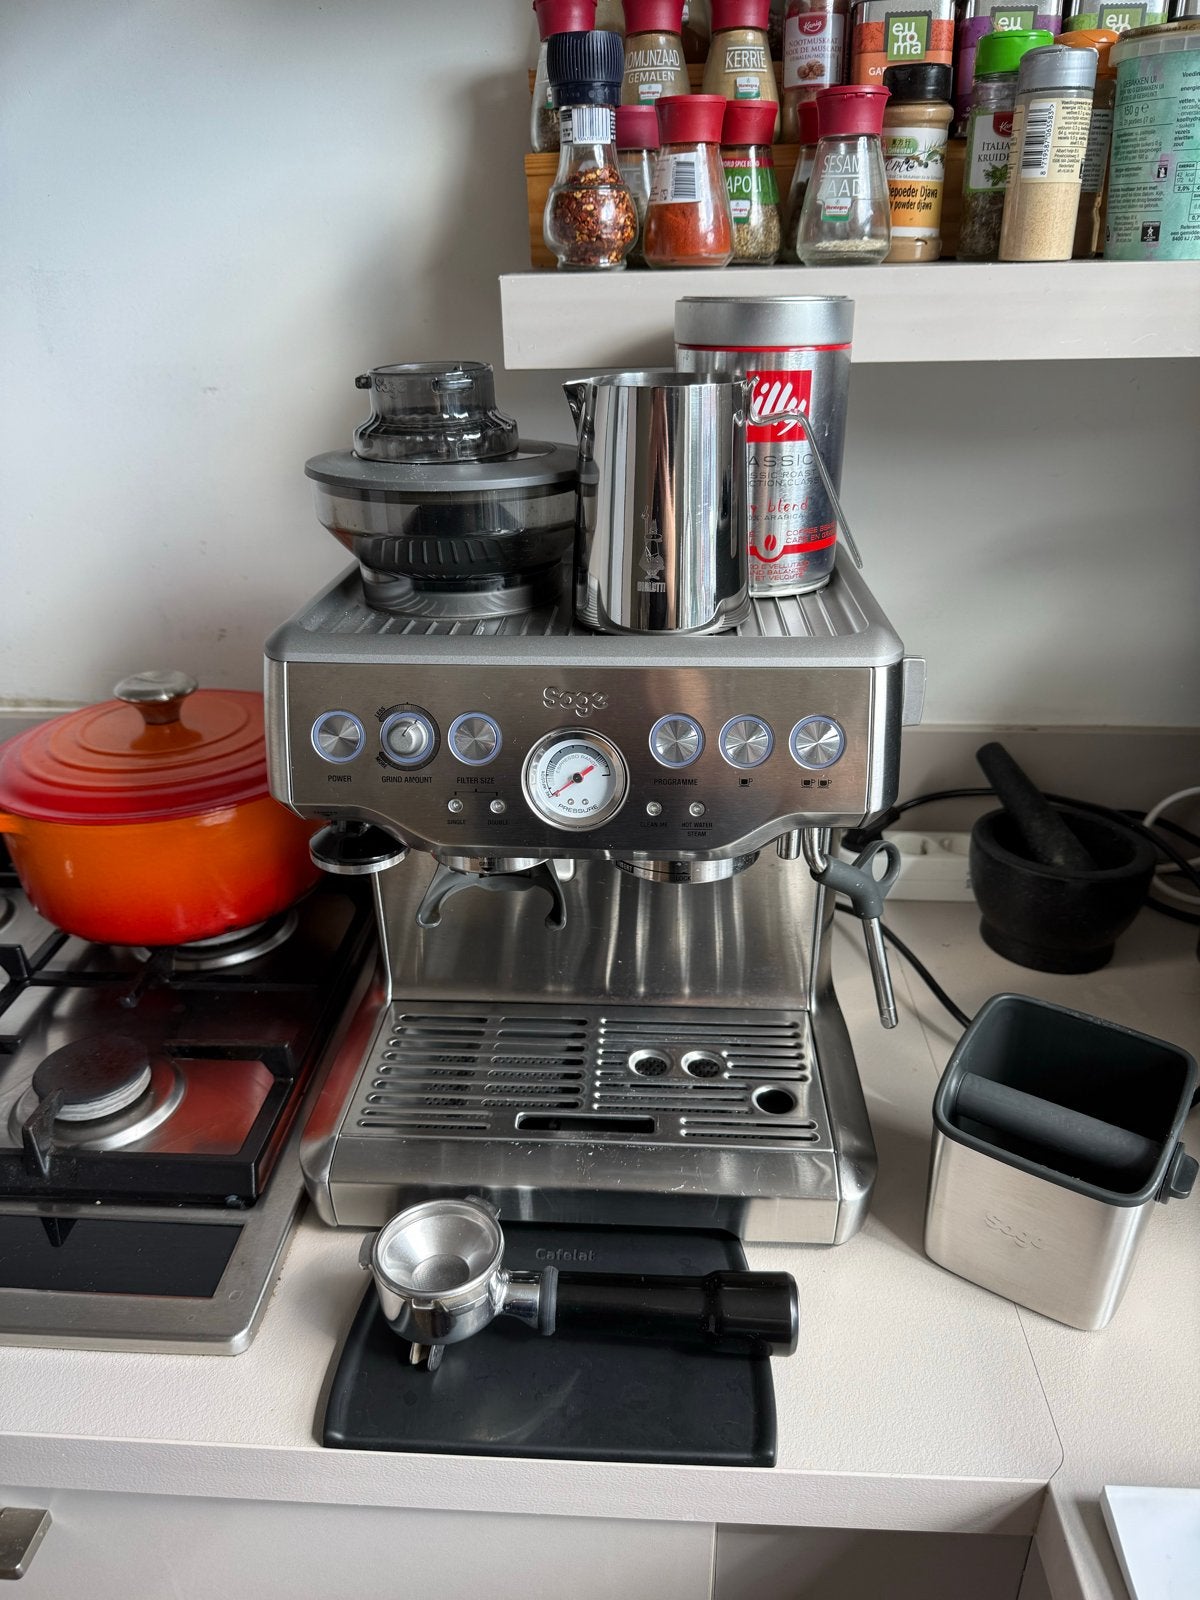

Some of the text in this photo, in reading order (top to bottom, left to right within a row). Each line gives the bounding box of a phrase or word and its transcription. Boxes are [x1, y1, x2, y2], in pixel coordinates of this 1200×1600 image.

[725, 50, 767, 68] KERRIE
[628, 71, 675, 83] GEMALEN
[1124, 105, 1134, 116] 150
[821, 179, 861, 197] AAD
[920, 185, 938, 200] Djawa
[894, 200, 916, 212] powder
[753, 380, 808, 437] illy
[749, 470, 779, 480] SSIC
[749, 480, 783, 488] CTION
[767, 496, 809, 513] blend
[327, 774, 352, 783] POWER
[381, 775, 433, 784] GRIND AMOUNT
[456, 776, 496, 785] FILTER SIZE
[653, 778, 698, 786] PROGRAMME
[558, 803, 599, 814] PRESSURE
[535, 1247, 596, 1261] Cafelat
